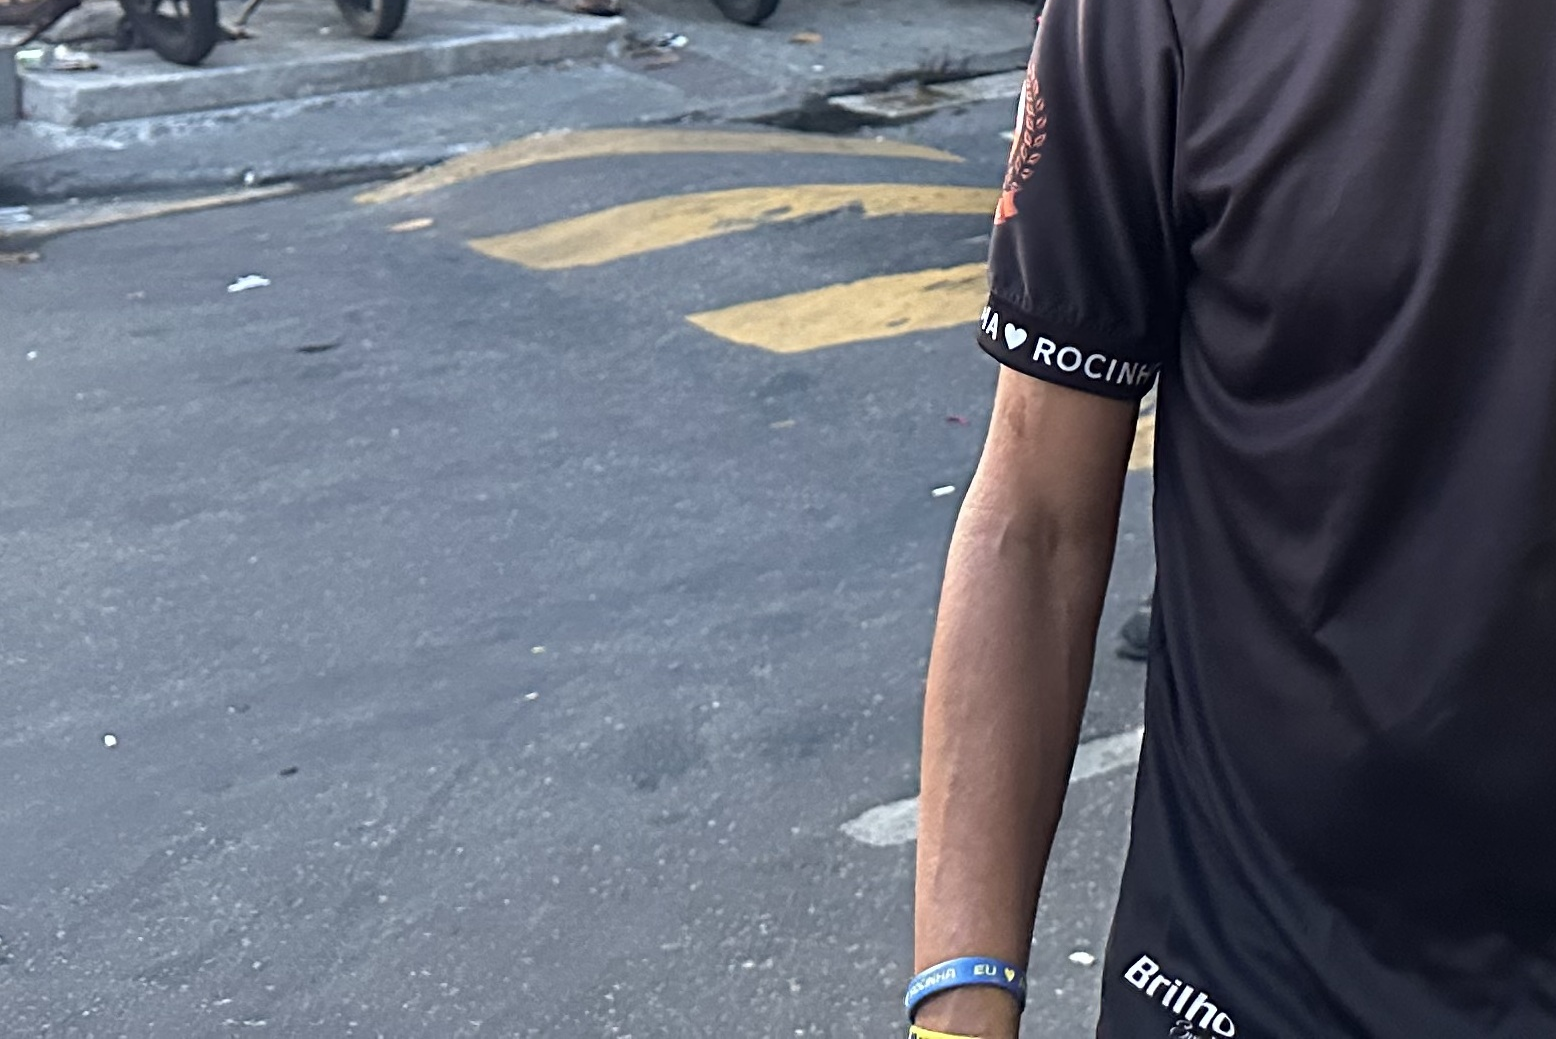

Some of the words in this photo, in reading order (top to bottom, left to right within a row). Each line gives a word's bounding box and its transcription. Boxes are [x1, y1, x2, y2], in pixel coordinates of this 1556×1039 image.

[1033, 336, 1160, 385] ROCINH
[973, 964, 997, 976] EU
[1124, 954, 1235, 1037] Brilho
